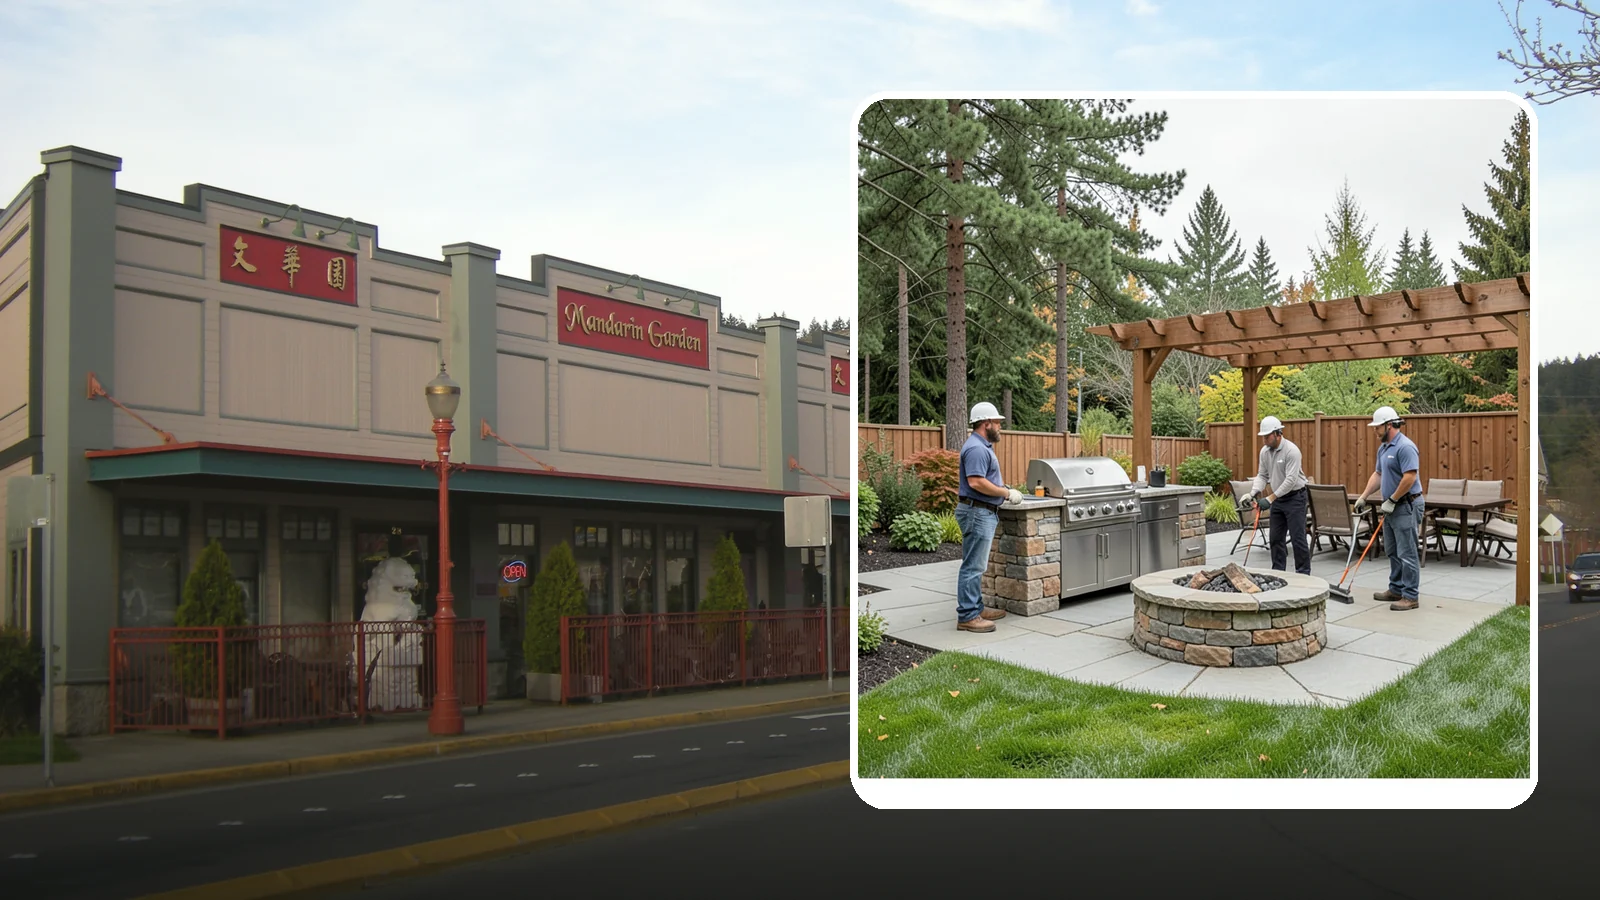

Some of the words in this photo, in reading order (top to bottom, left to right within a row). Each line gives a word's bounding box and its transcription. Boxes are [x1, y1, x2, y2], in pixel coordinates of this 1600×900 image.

[230, 235, 346, 291] 文華園
[564, 302, 644, 341] Mandarin
[648, 320, 701, 352] Garden
[503, 565, 527, 578] OPEN
